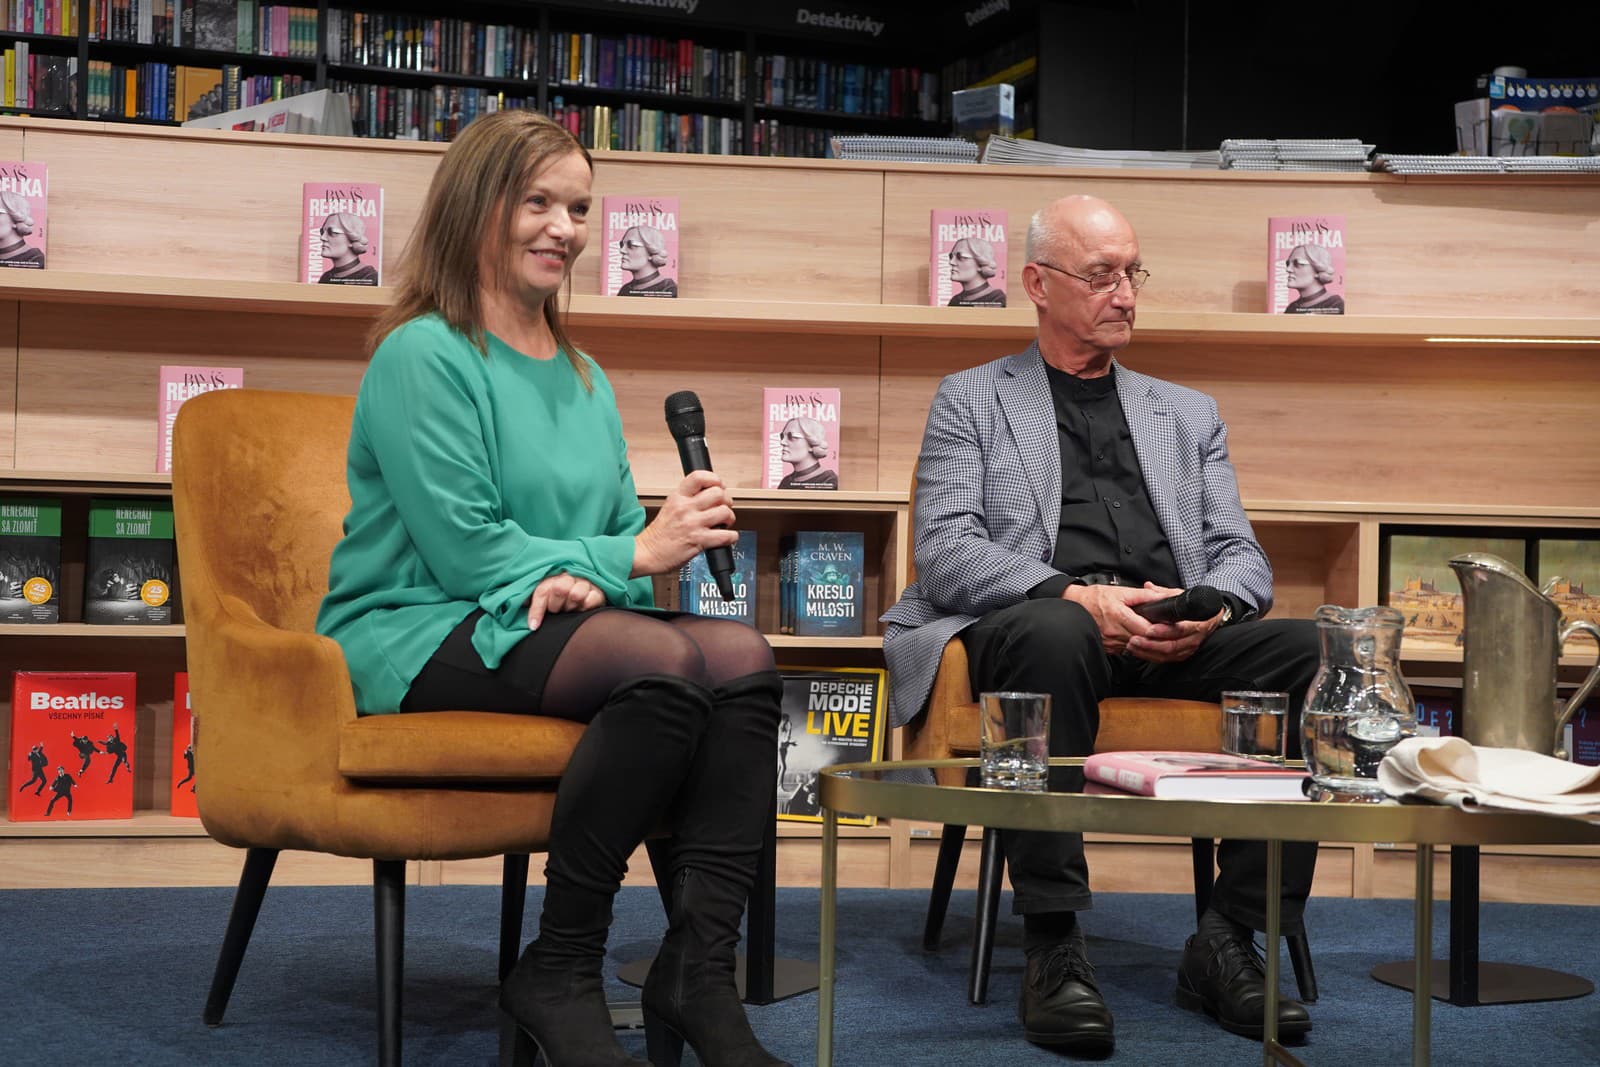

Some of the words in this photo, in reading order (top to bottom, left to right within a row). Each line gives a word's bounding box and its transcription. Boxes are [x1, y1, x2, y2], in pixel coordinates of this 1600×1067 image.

[796, 8, 885, 37] Detektívky
[1, 520, 11, 533] SA
[12, 517, 37, 533] ZLOMIŤ
[115, 522, 125, 535] SA
[126, 520, 151, 536] ZLOMIŤ
[818, 543, 830, 552] M.
[833, 543, 845, 552] W.
[810, 552, 852, 562] CRAVEN
[807, 584, 854, 600] KRESLO
[699, 600, 748, 617] MILOSTI
[806, 602, 855, 618] MILOSTI
[809, 681, 874, 696] DEPECHE
[30, 692, 124, 711] Beatles
[808, 694, 872, 714] MODE
[805, 711, 871, 738] LIVE
